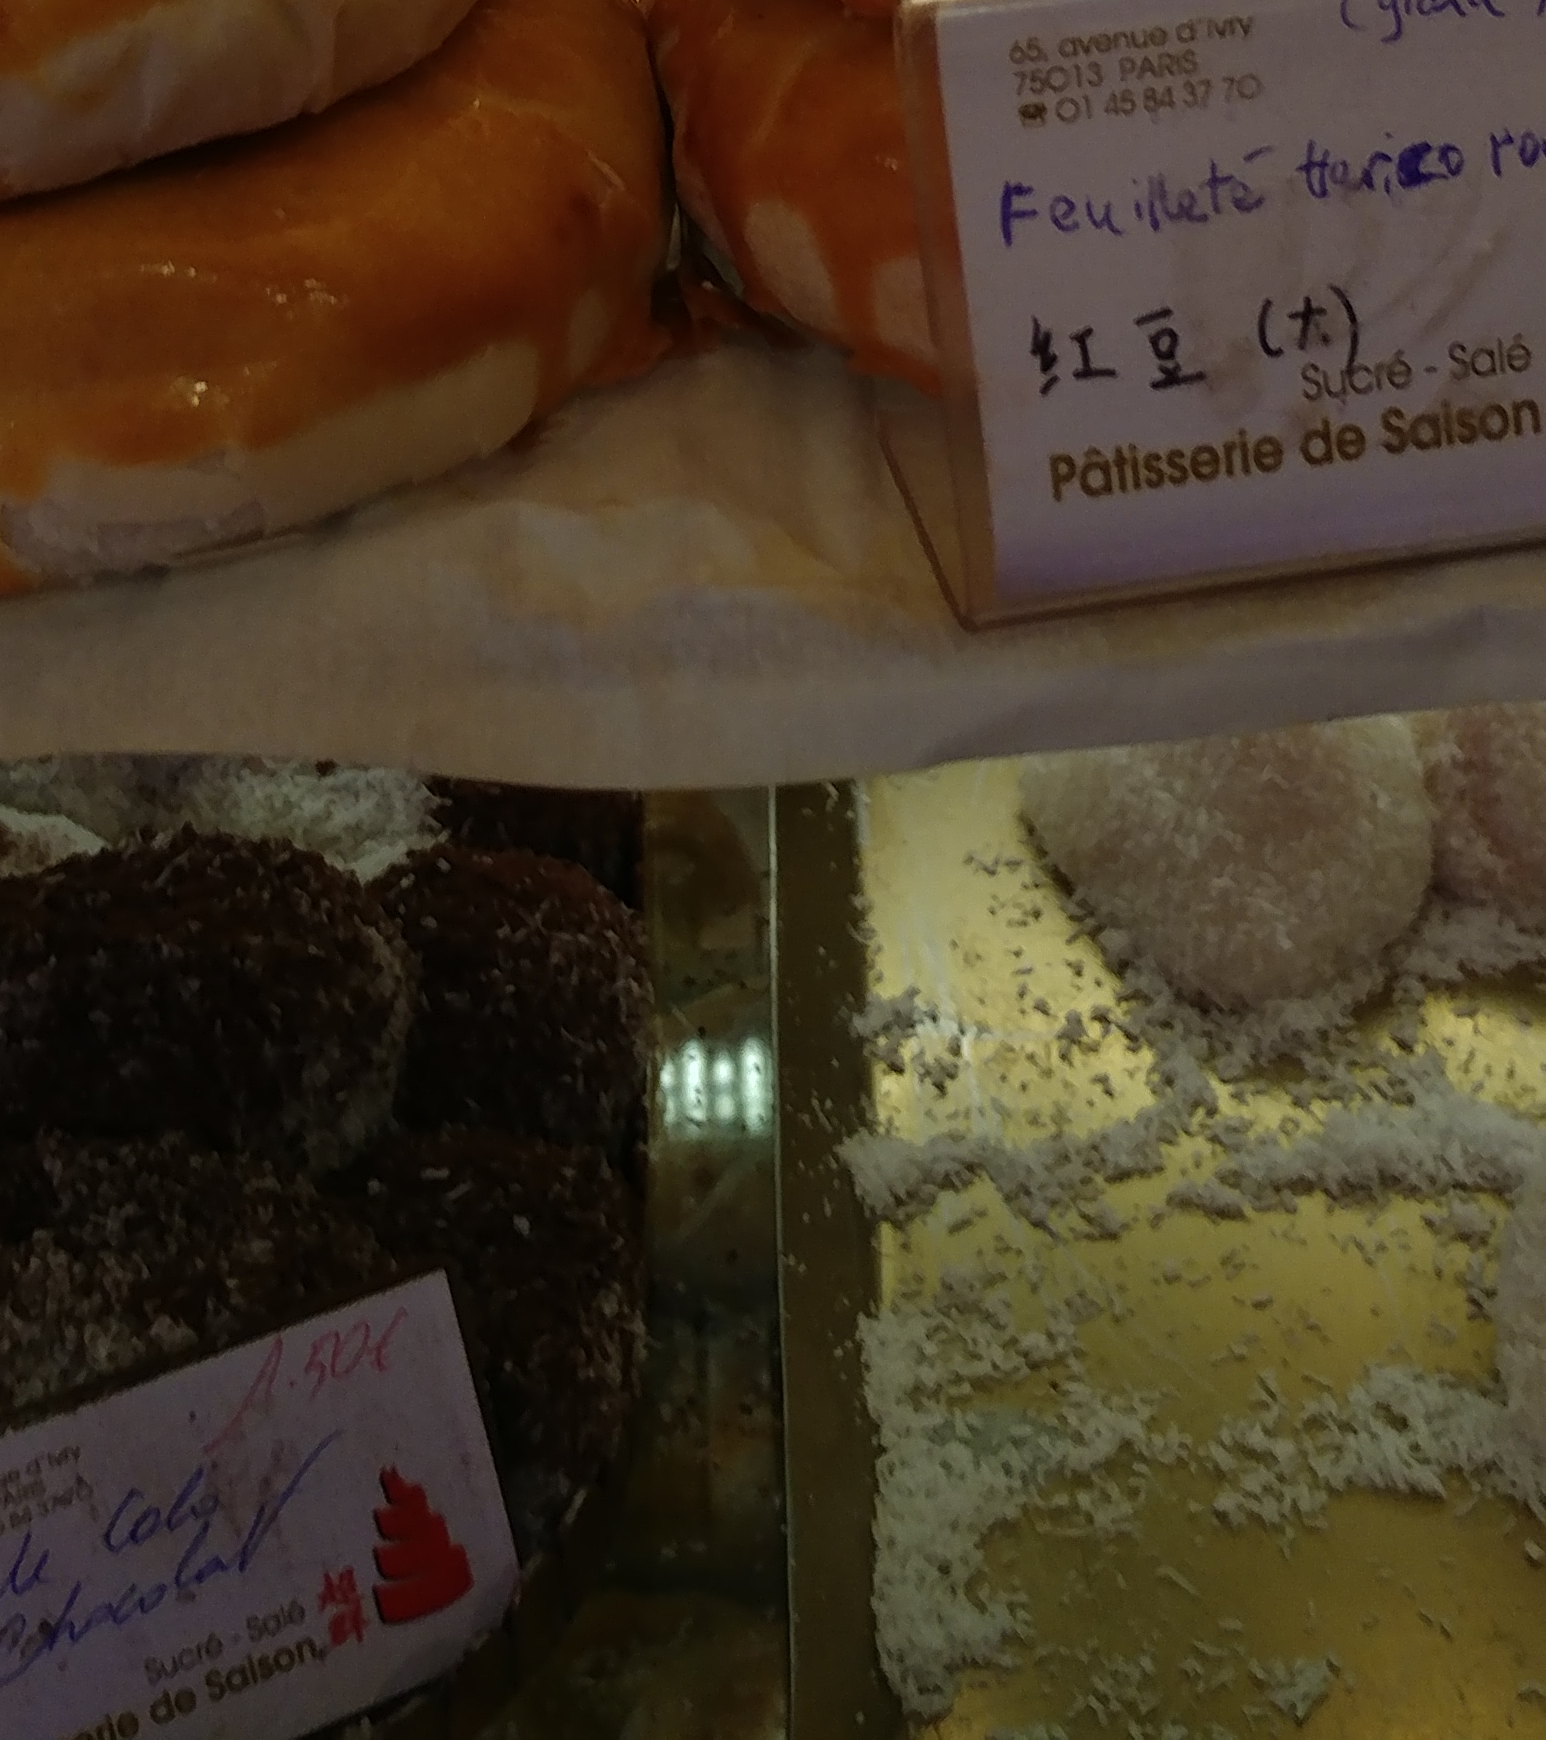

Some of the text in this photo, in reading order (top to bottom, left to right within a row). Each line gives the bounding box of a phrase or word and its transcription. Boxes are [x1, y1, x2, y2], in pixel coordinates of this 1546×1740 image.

[1057, 26, 1168, 58] avenue
[1176, 15, 1254, 45] d'Ivry
[1013, 49, 1199, 96] 75013 PARIS
[1055, 94, 1094, 123] 01
[1143, 85, 1176, 113] 84
[1182, 77, 1213, 108] 37
[1222, 73, 1264, 101] 70
[1300, 348, 1413, 403] Sucré
[1449, 332, 1533, 379] Salé
[1050, 396, 1542, 501] Pâtisserie de Saison
[144, 1632, 224, 1687] Sucré
[245, 1599, 307, 1643] Salé
[149, 1686, 197, 1727] de
[204, 1636, 320, 1703] Saison
